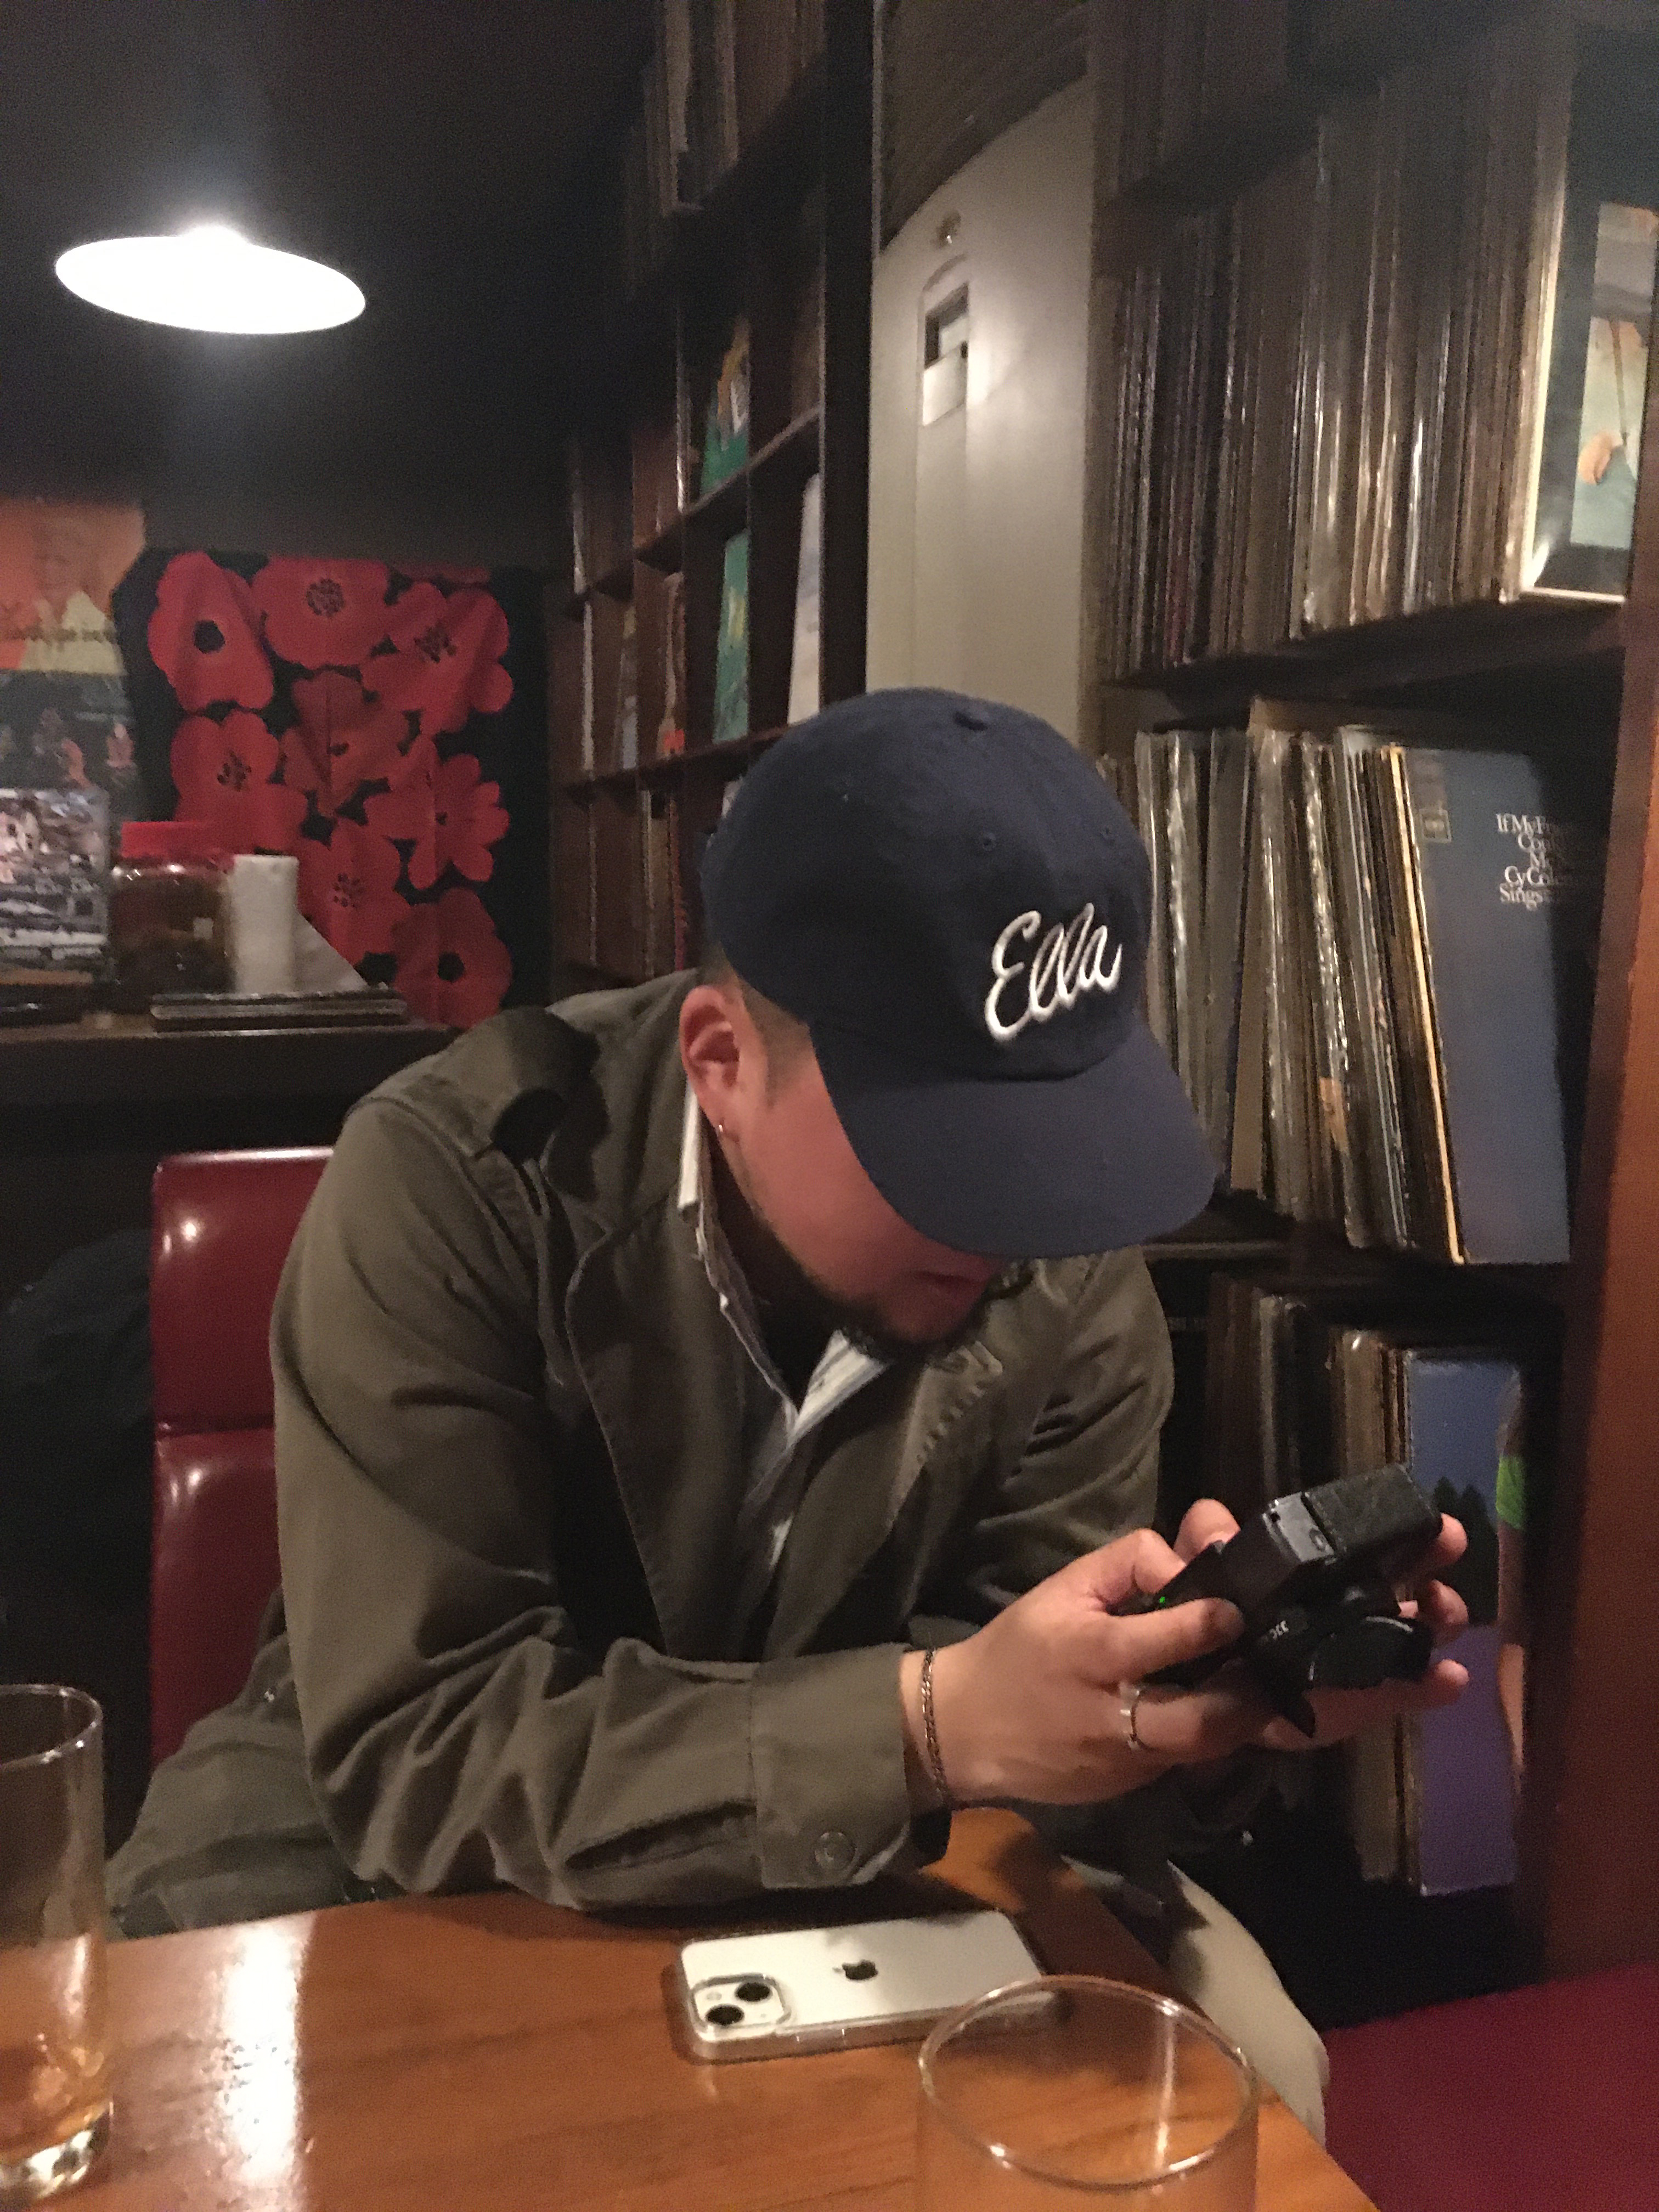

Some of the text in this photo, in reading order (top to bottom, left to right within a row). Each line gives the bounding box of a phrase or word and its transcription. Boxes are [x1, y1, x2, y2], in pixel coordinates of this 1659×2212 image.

[1496, 813, 1511, 832] If
[1504, 865, 1526, 888] Cy
[985, 902, 1122, 1042] Ella
